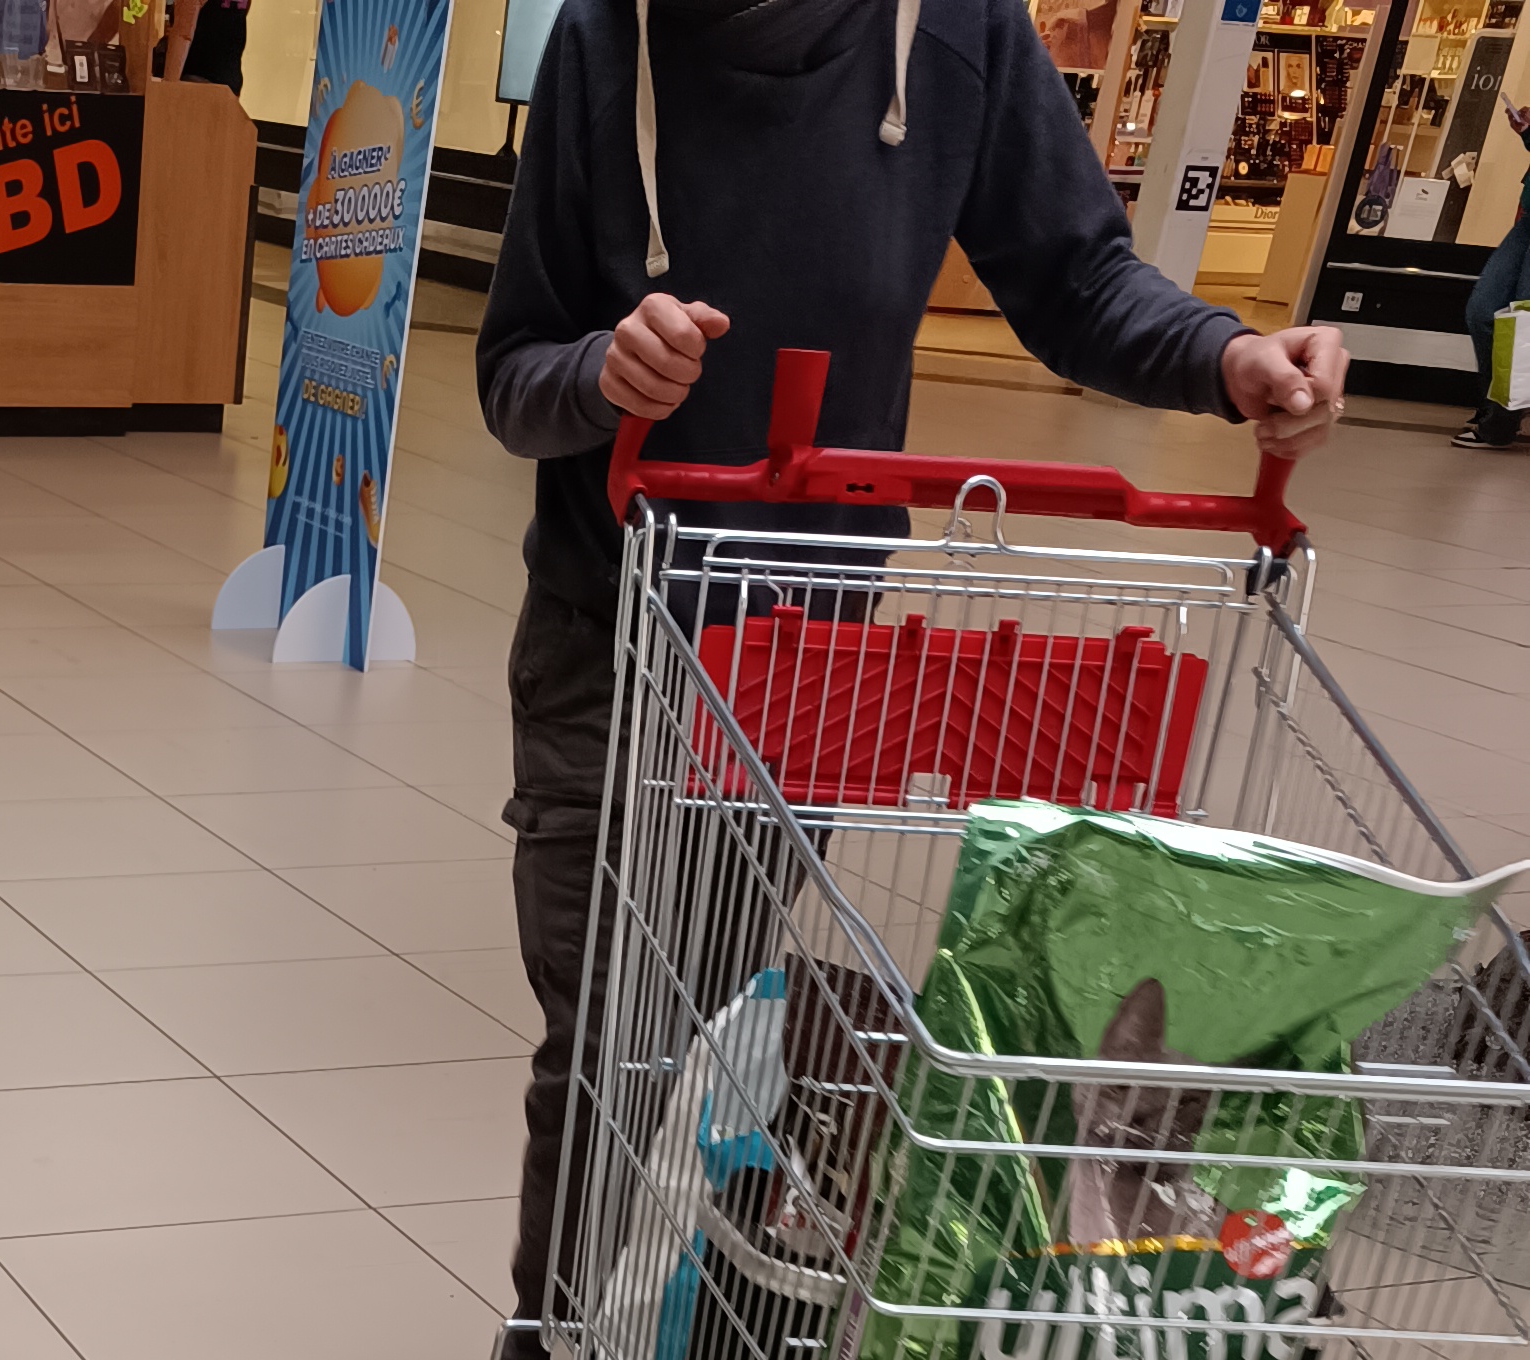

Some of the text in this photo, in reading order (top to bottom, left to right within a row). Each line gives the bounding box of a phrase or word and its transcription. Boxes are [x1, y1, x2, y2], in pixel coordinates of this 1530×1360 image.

[42, 95, 81, 137] ici
[315, 203, 332, 228] DE
[315, 233, 353, 258] CARTES
[354, 227, 405, 255] CADEAUX
[303, 379, 316, 402] DE
